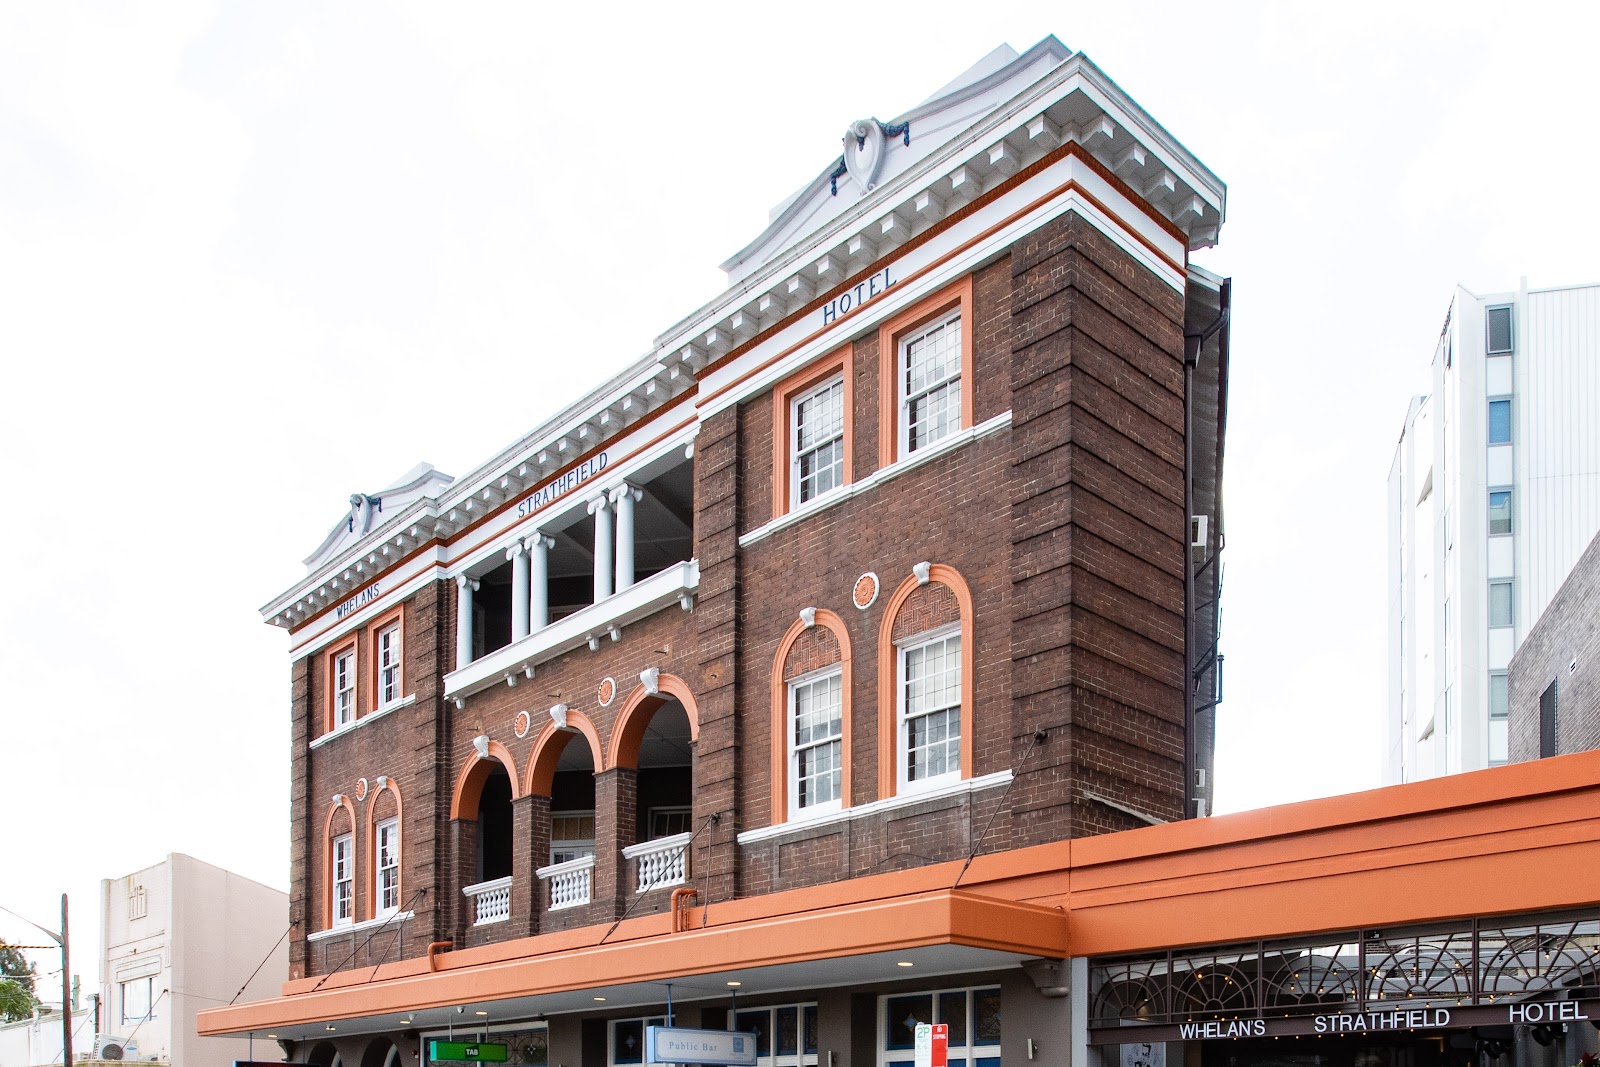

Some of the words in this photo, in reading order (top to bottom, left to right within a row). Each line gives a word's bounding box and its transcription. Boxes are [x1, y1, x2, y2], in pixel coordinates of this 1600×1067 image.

[337, 583, 379, 619] WHELANS
[518, 452, 608, 518] STRATHFIELD
[823, 268, 897, 326] HOTEL
[1179, 1019, 1266, 1040] WHELAN'S
[1314, 1008, 1450, 1033] STRATHFIELD
[1509, 1001, 1588, 1023] HOTEL
[917, 1027, 930, 1039] 2P
[465, 1048, 479, 1056] TAB
[669, 1041, 698, 1051] Public
[702, 1042, 718, 1052] Bar
